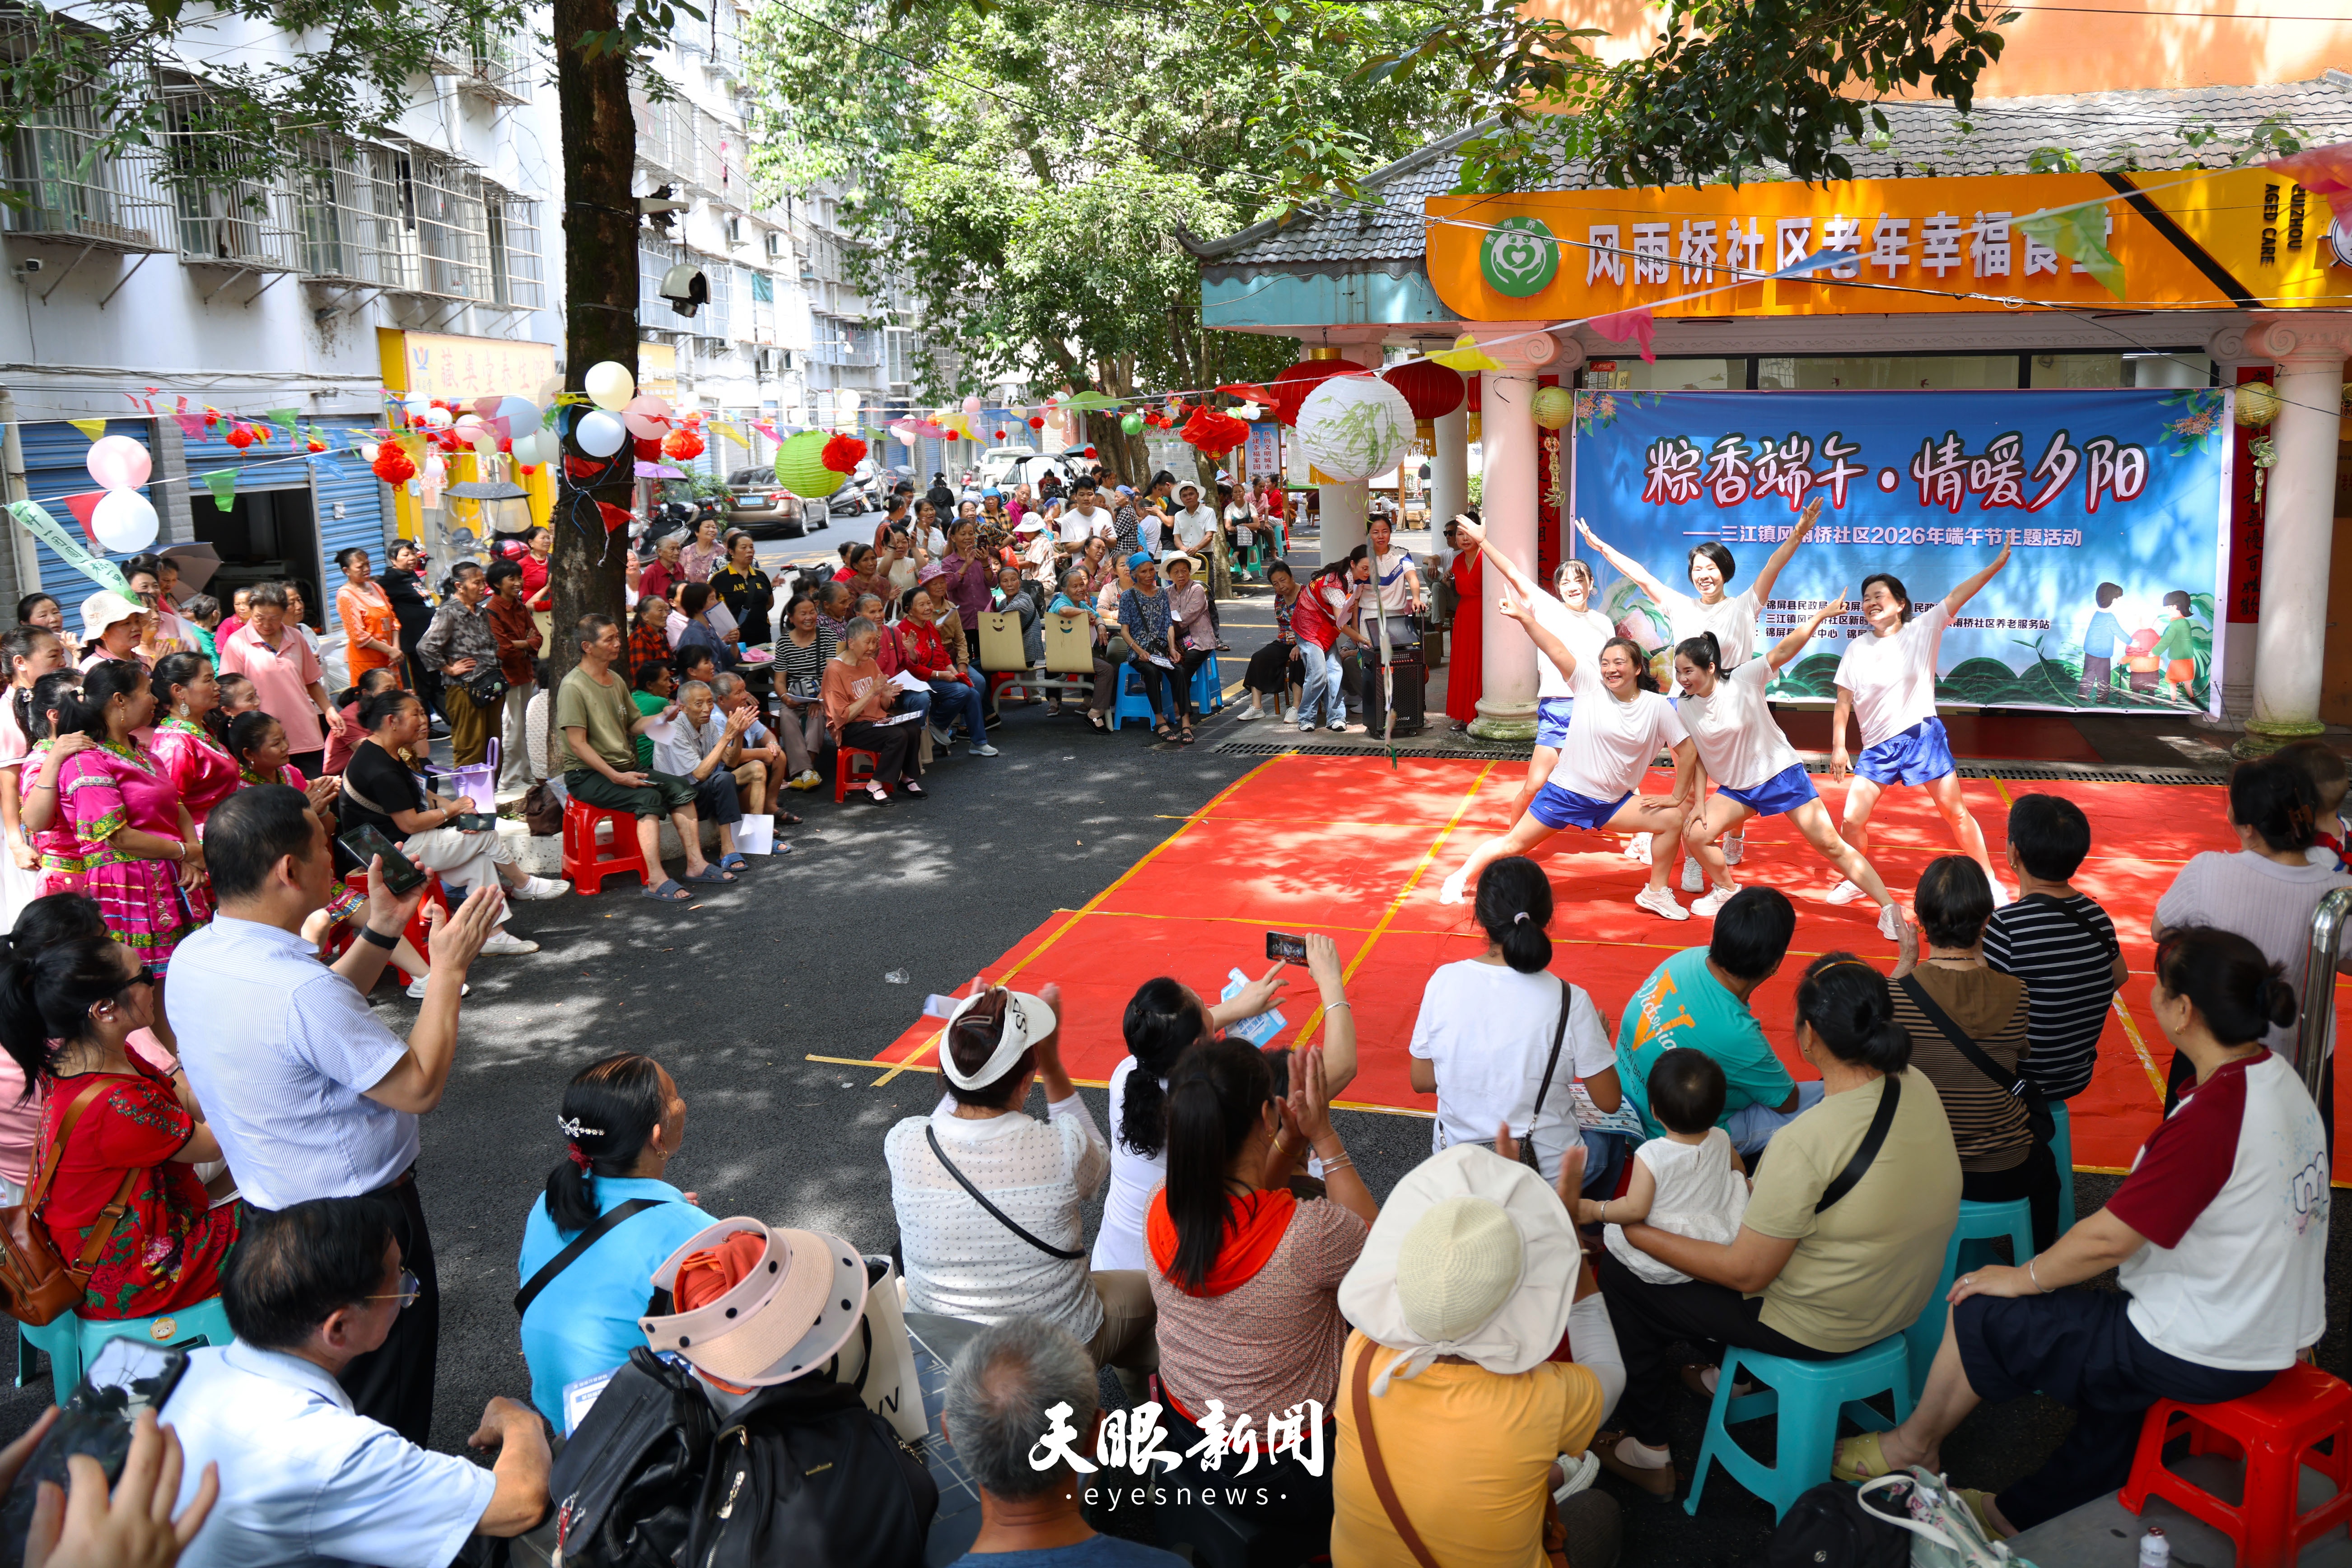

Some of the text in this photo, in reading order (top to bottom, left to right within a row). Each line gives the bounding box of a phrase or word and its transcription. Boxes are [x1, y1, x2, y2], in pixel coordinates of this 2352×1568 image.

[2260, 183, 2280, 266] AGED CARE
[1144, 426, 1181, 439] 健康教育
[1252, 431, 1261, 470] 共建幸福家园
[1263, 431, 1272, 470] 共创文明城市
[1644, 430, 2151, 513] 粽香端午·情暖夕阳
[1948, 618, 2050, 630] 雨桥社区养老服务站
[1637, 975, 1677, 1051] Victoria
